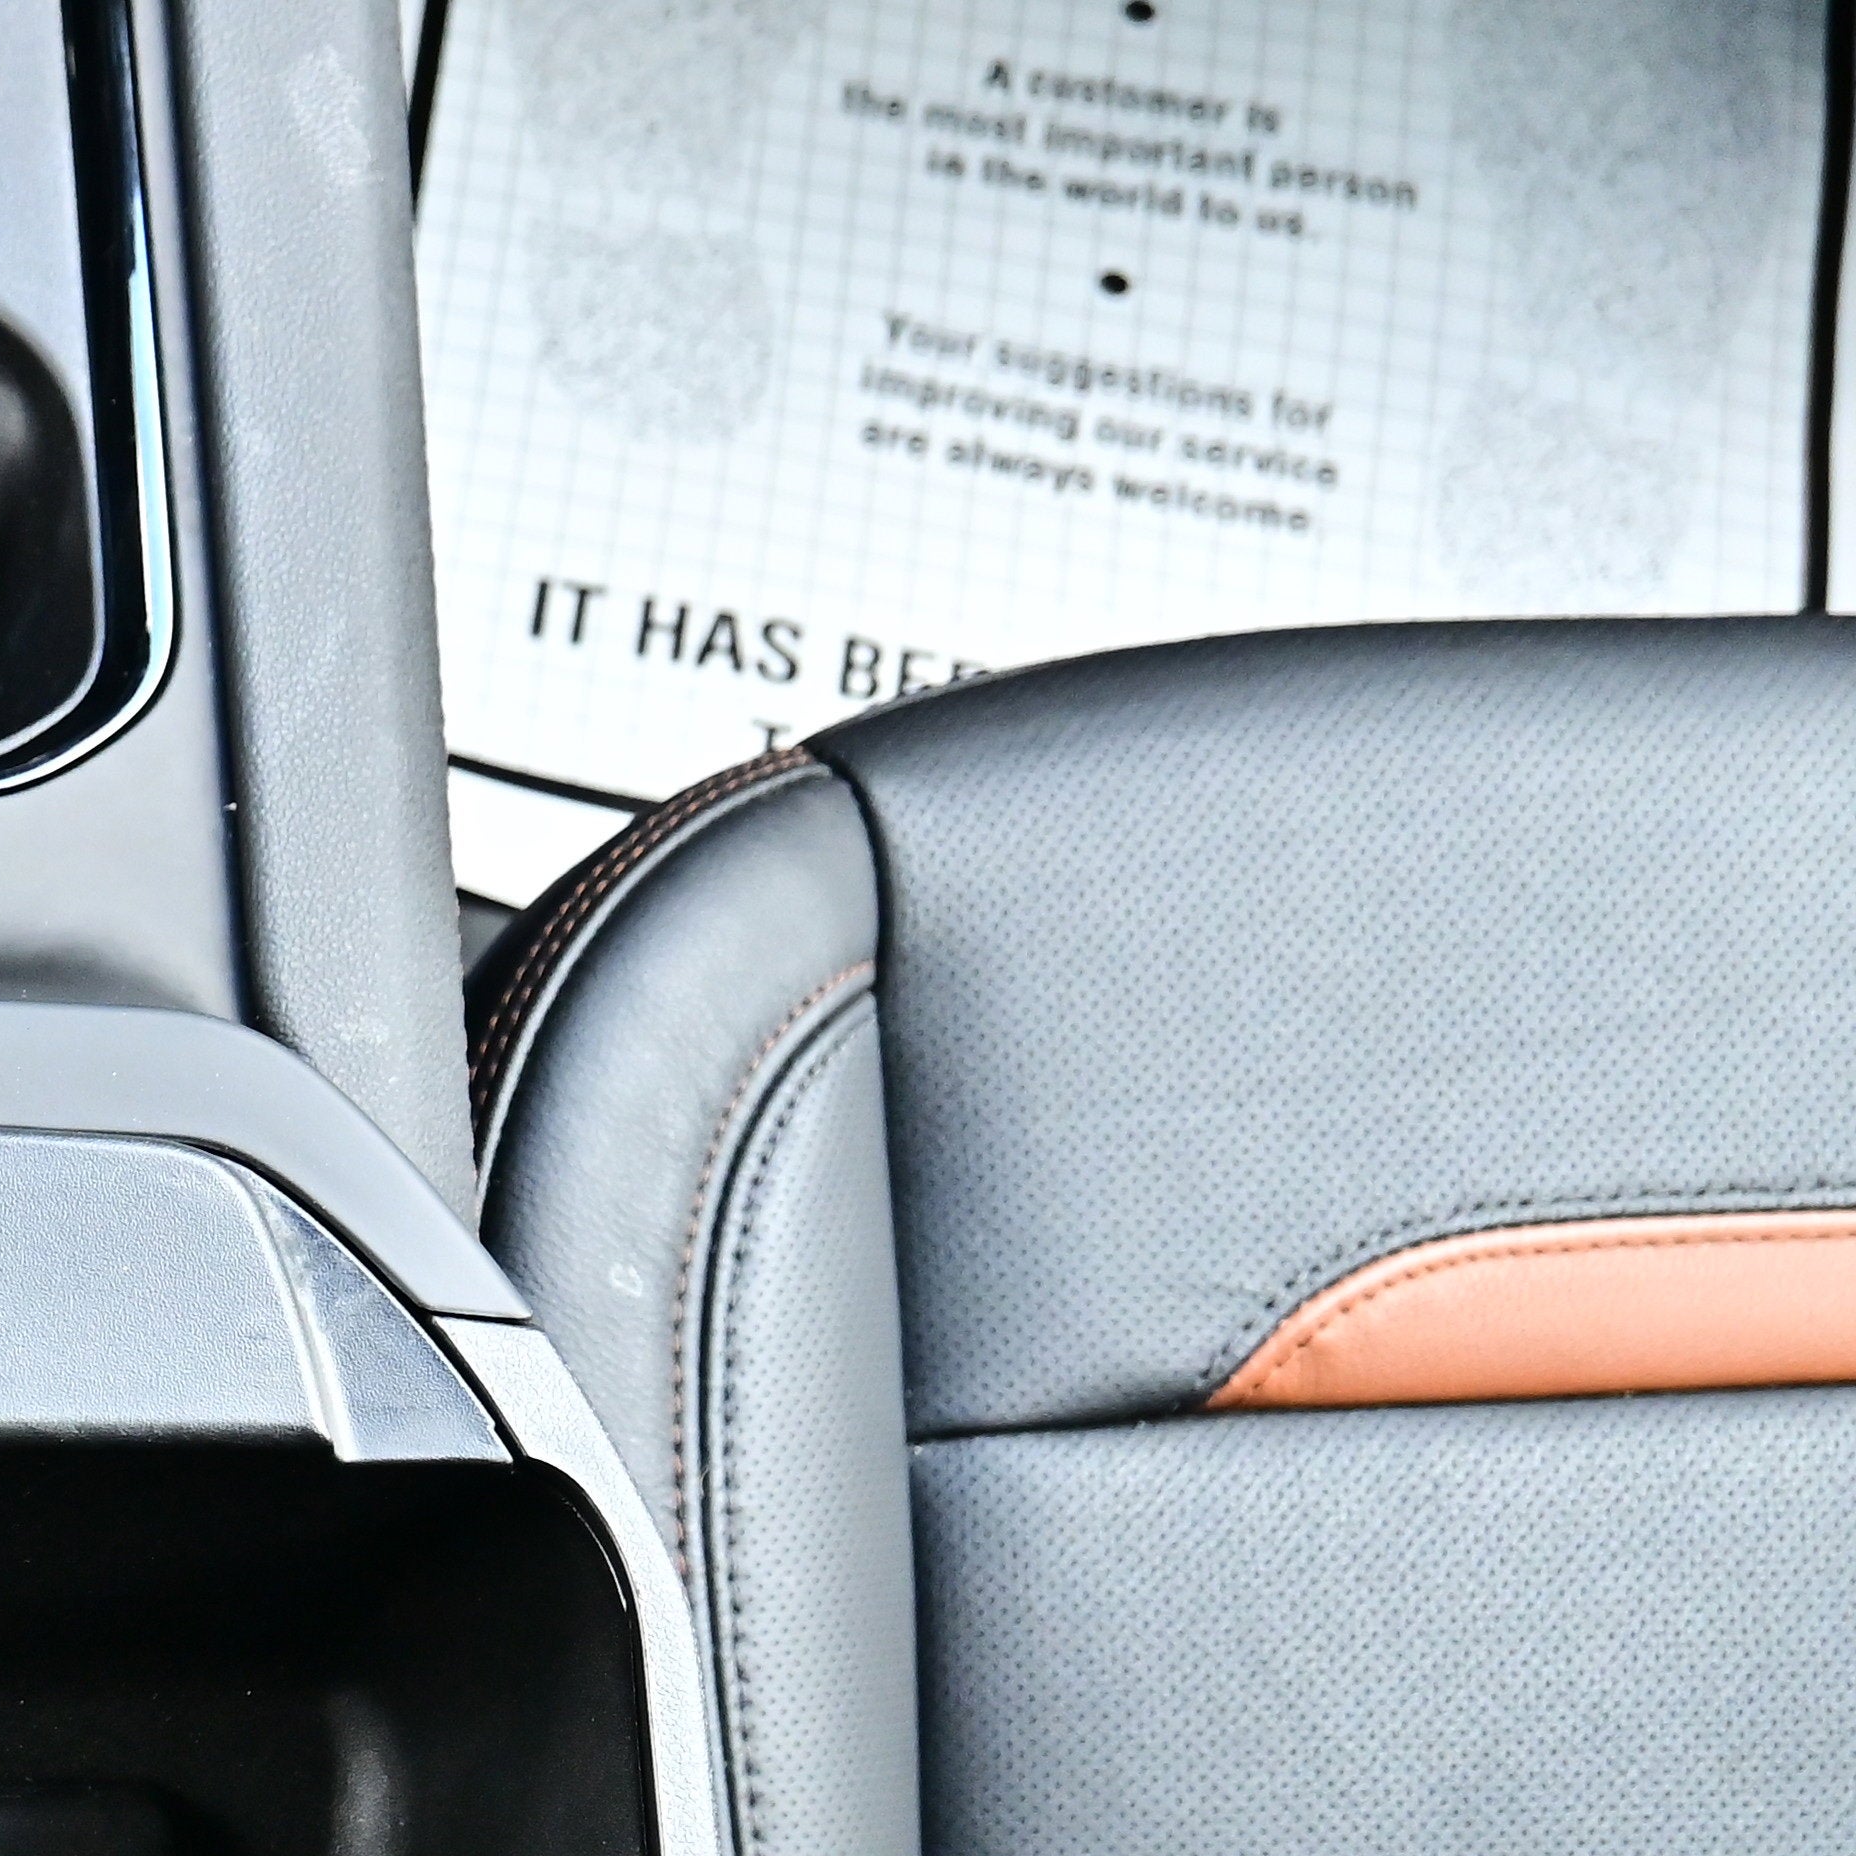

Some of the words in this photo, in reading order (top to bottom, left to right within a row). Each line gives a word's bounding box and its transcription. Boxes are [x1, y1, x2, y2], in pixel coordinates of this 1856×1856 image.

[841, 79, 908, 123] the
[922, 104, 1027, 144] most
[1043, 120, 1257, 185] important
[1268, 155, 1419, 211] person
[985, 58, 1012, 91] A
[1029, 68, 1229, 122] customer
[1246, 99, 1281, 134] is
[982, 153, 1047, 192] the
[1062, 175, 1185, 218] world
[1198, 190, 1241, 226] to
[885, 310, 979, 358] Your
[994, 340, 1255, 421] suggestions
[1271, 387, 1333, 432] for
[860, 361, 1083, 441] improving
[1093, 415, 1163, 451] our
[1181, 434, 1339, 491] service
[861, 419, 928, 457] are
[947, 432, 1096, 494] always
[529, 576, 609, 645] IT
[635, 594, 805, 685] HAS
